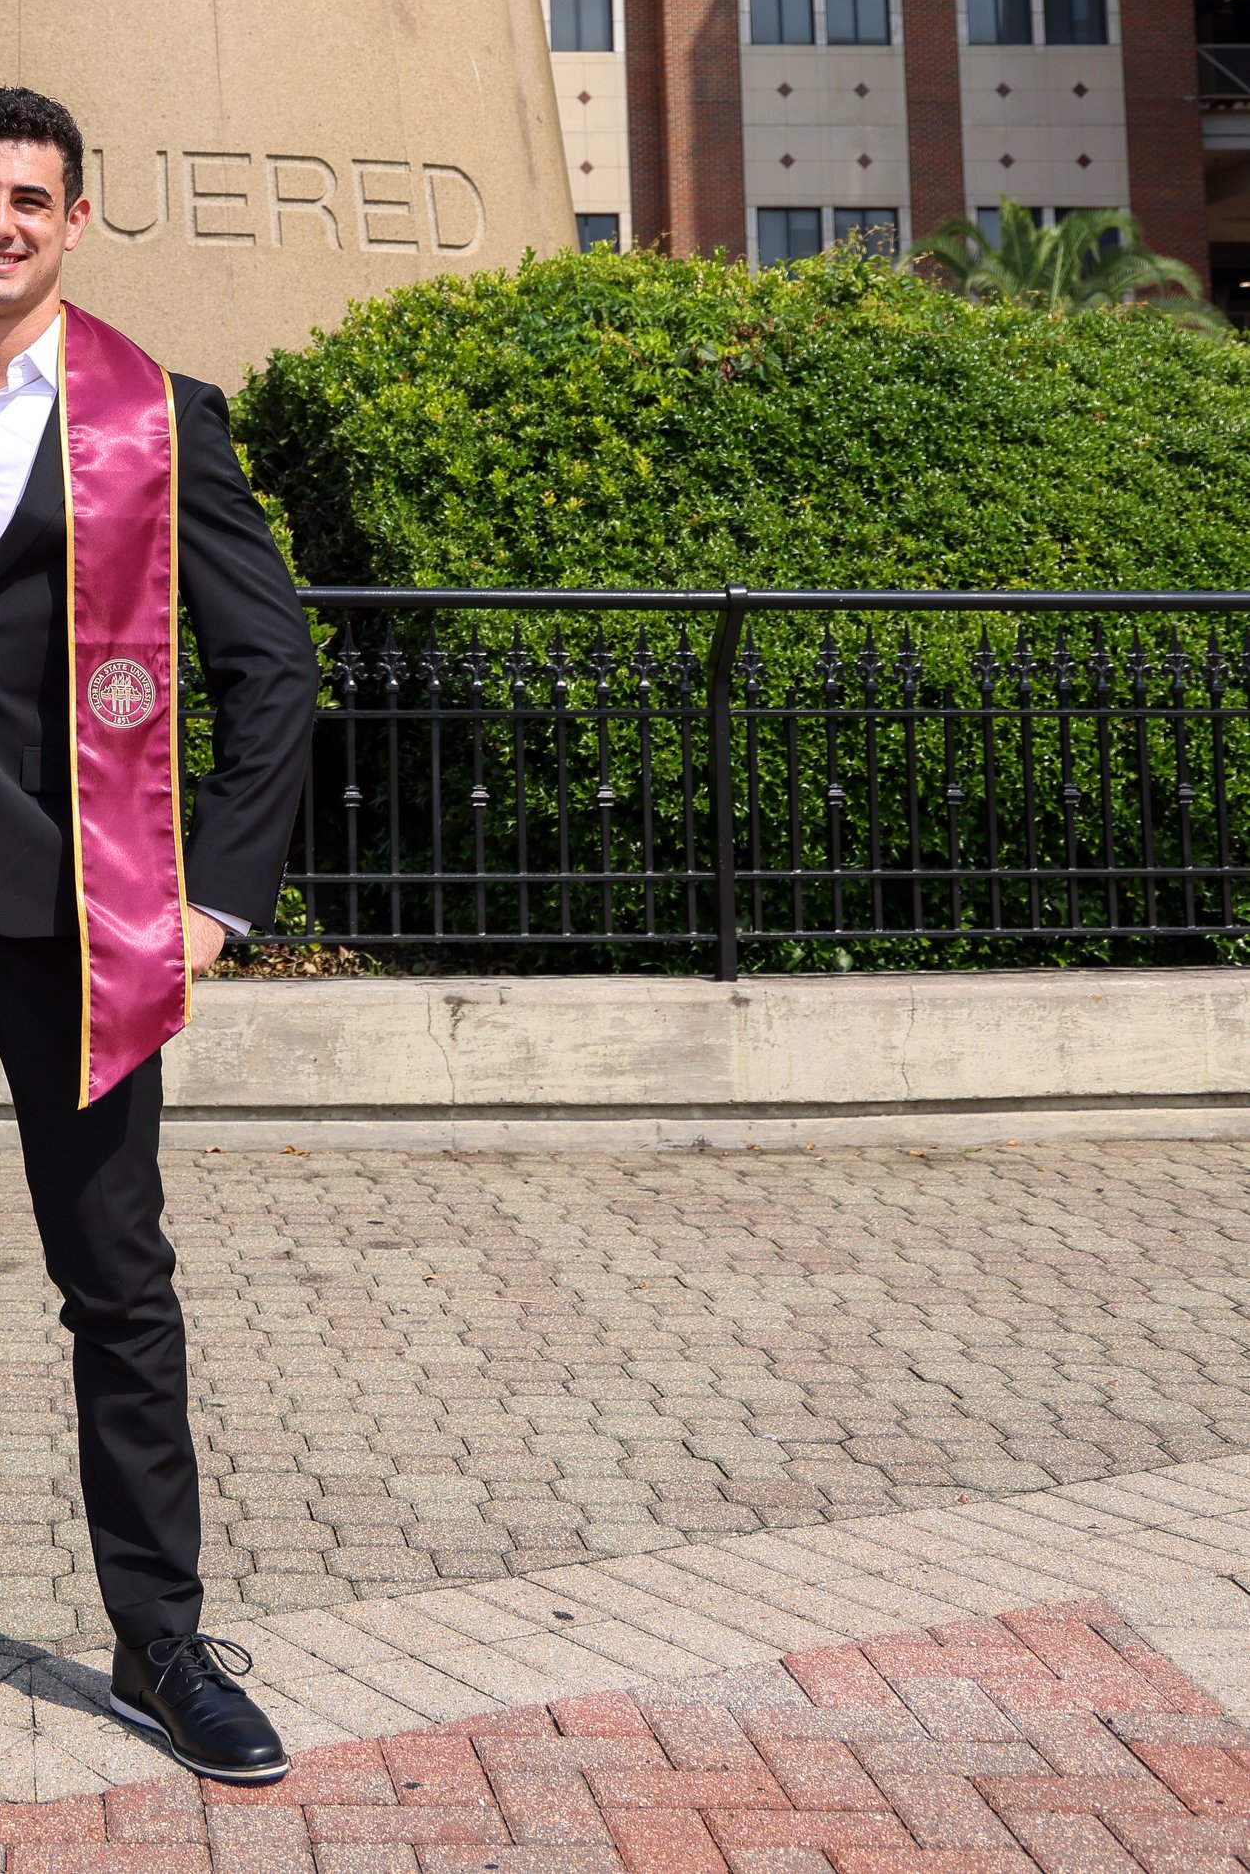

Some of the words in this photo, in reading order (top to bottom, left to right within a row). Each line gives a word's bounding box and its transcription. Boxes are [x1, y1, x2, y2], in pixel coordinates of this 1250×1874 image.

[92, 673, 105, 710] FLORIDA
[104, 663, 128, 674] STATE
[130, 666, 152, 712] UNIVERSITY
[114, 717, 130, 725] 1851
